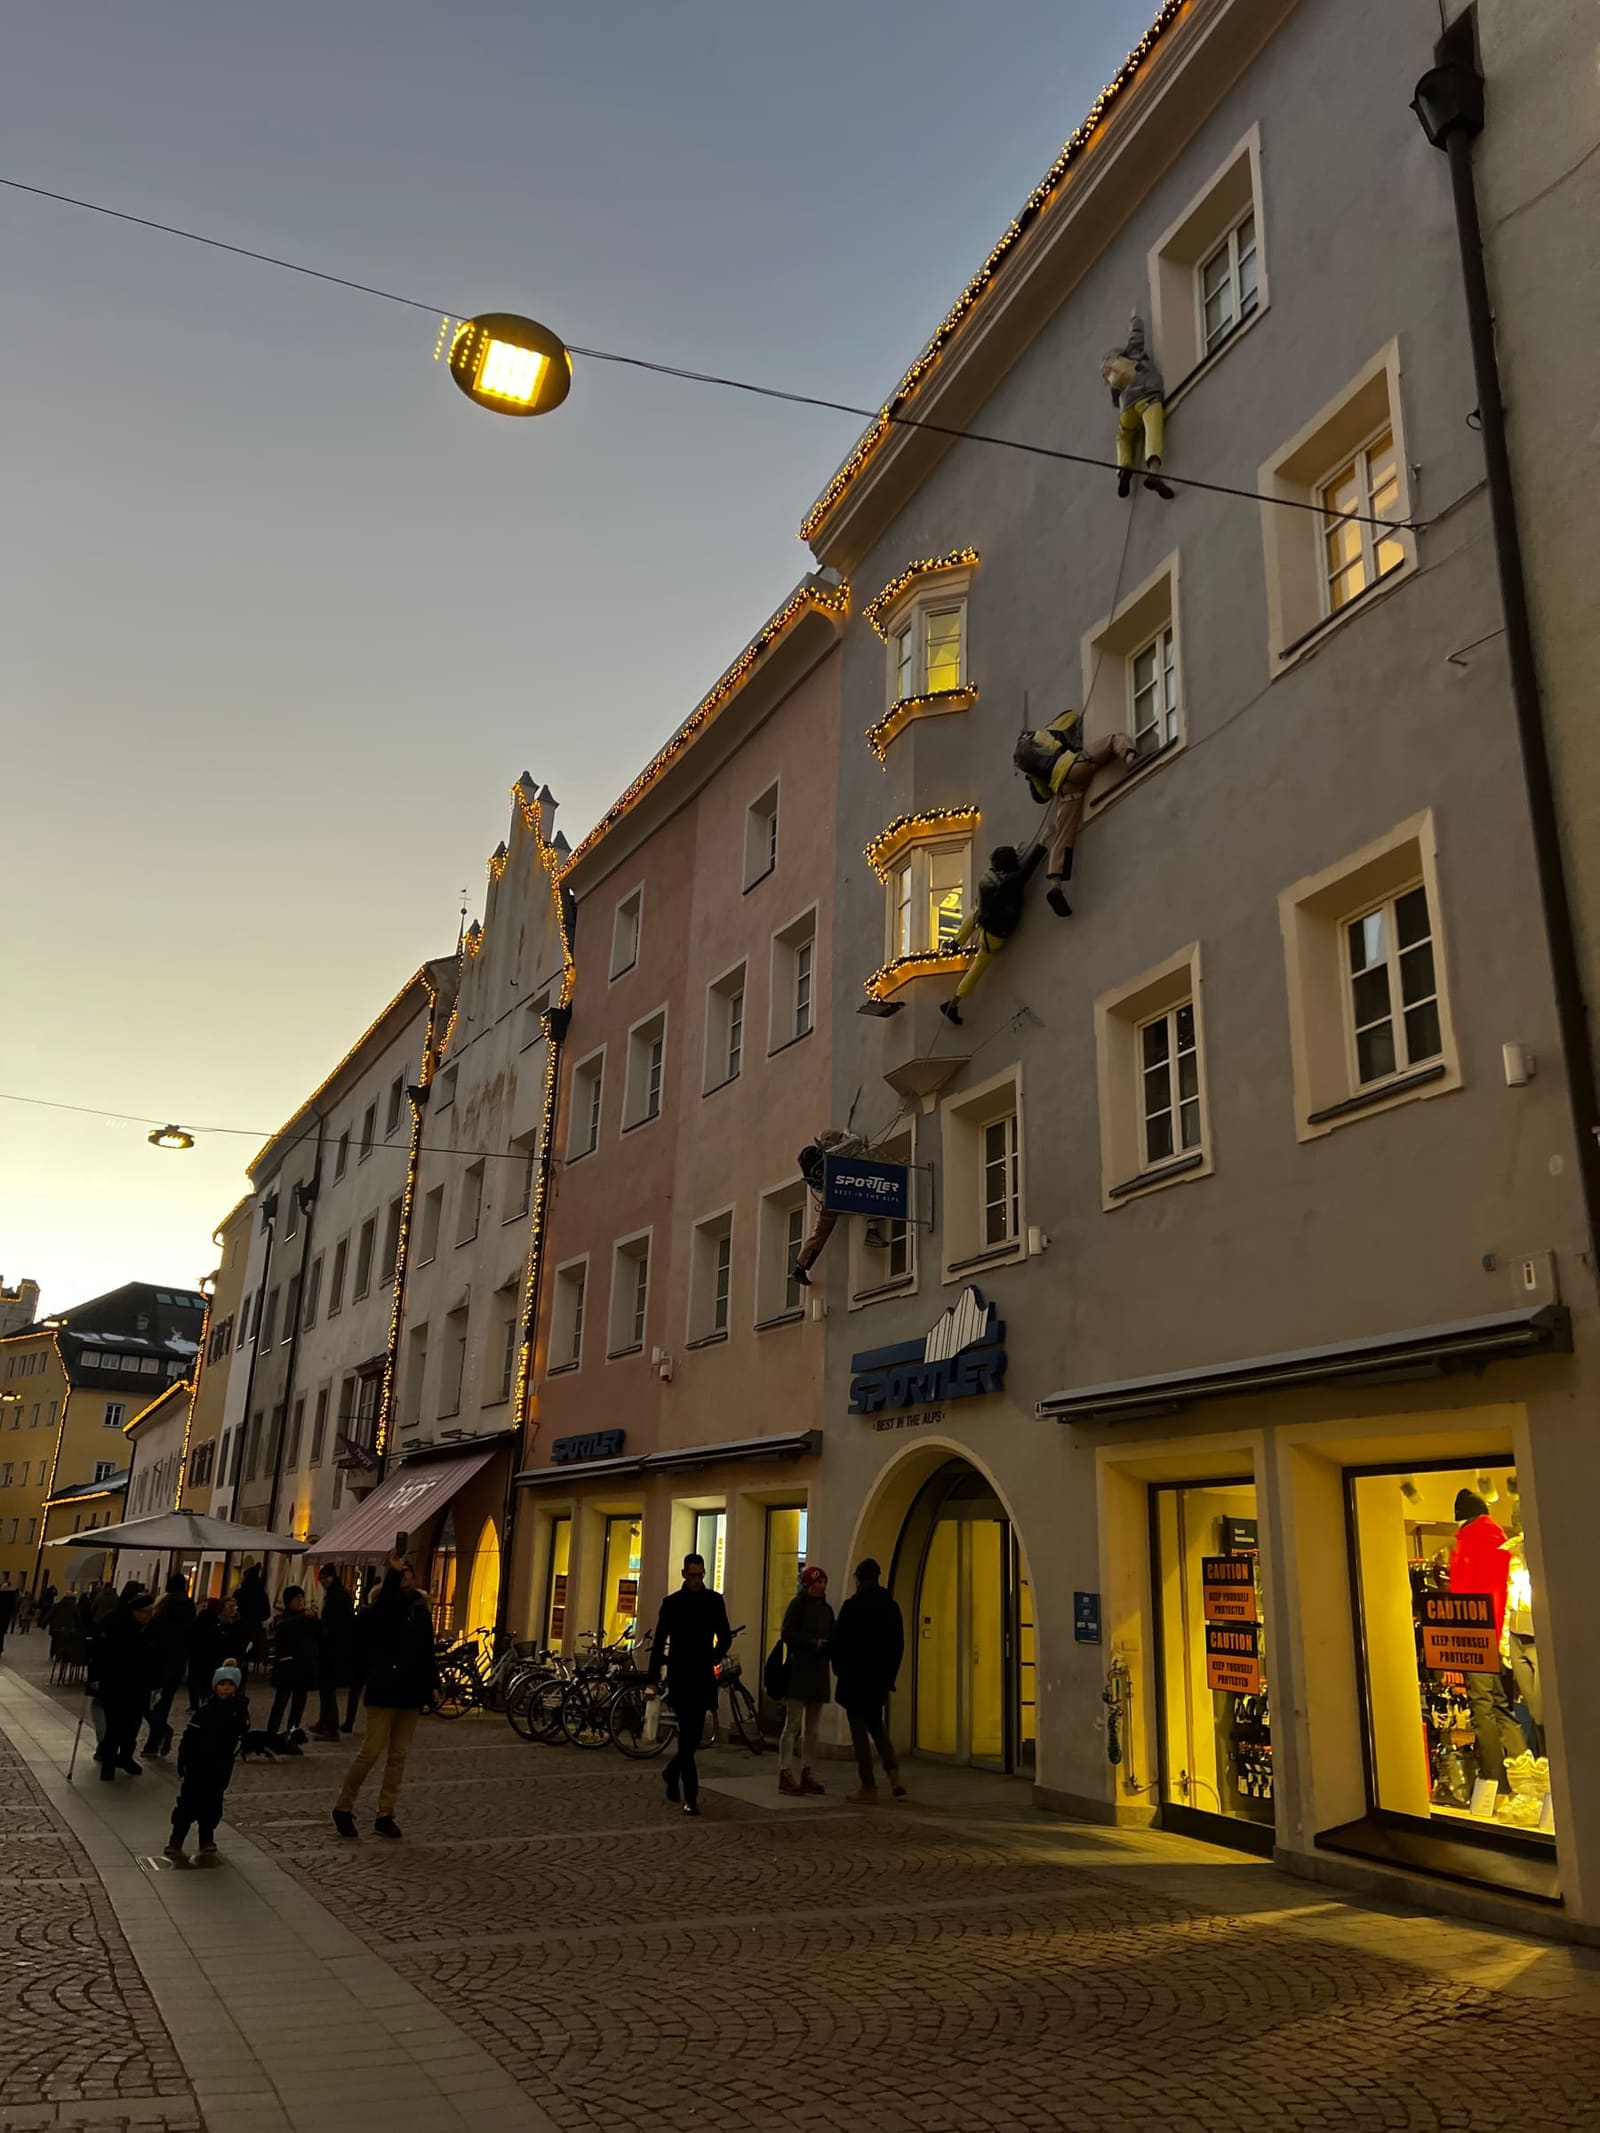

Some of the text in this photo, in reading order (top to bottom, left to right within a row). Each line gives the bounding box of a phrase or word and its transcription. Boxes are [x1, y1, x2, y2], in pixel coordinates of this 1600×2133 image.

[834, 1175, 900, 1194] SPORTLER
[848, 1349, 1008, 1415] SPORTLER
[876, 1410, 942, 1431] BEST IN THE ALPS
[550, 1428, 625, 1463] SPORTLER
[1207, 1562, 1249, 1580] CAUTION
[1427, 1599, 1488, 1621] CAUTION
[1210, 1631, 1253, 1651] CAUTION
[1432, 1634, 1448, 1646] KEEP
